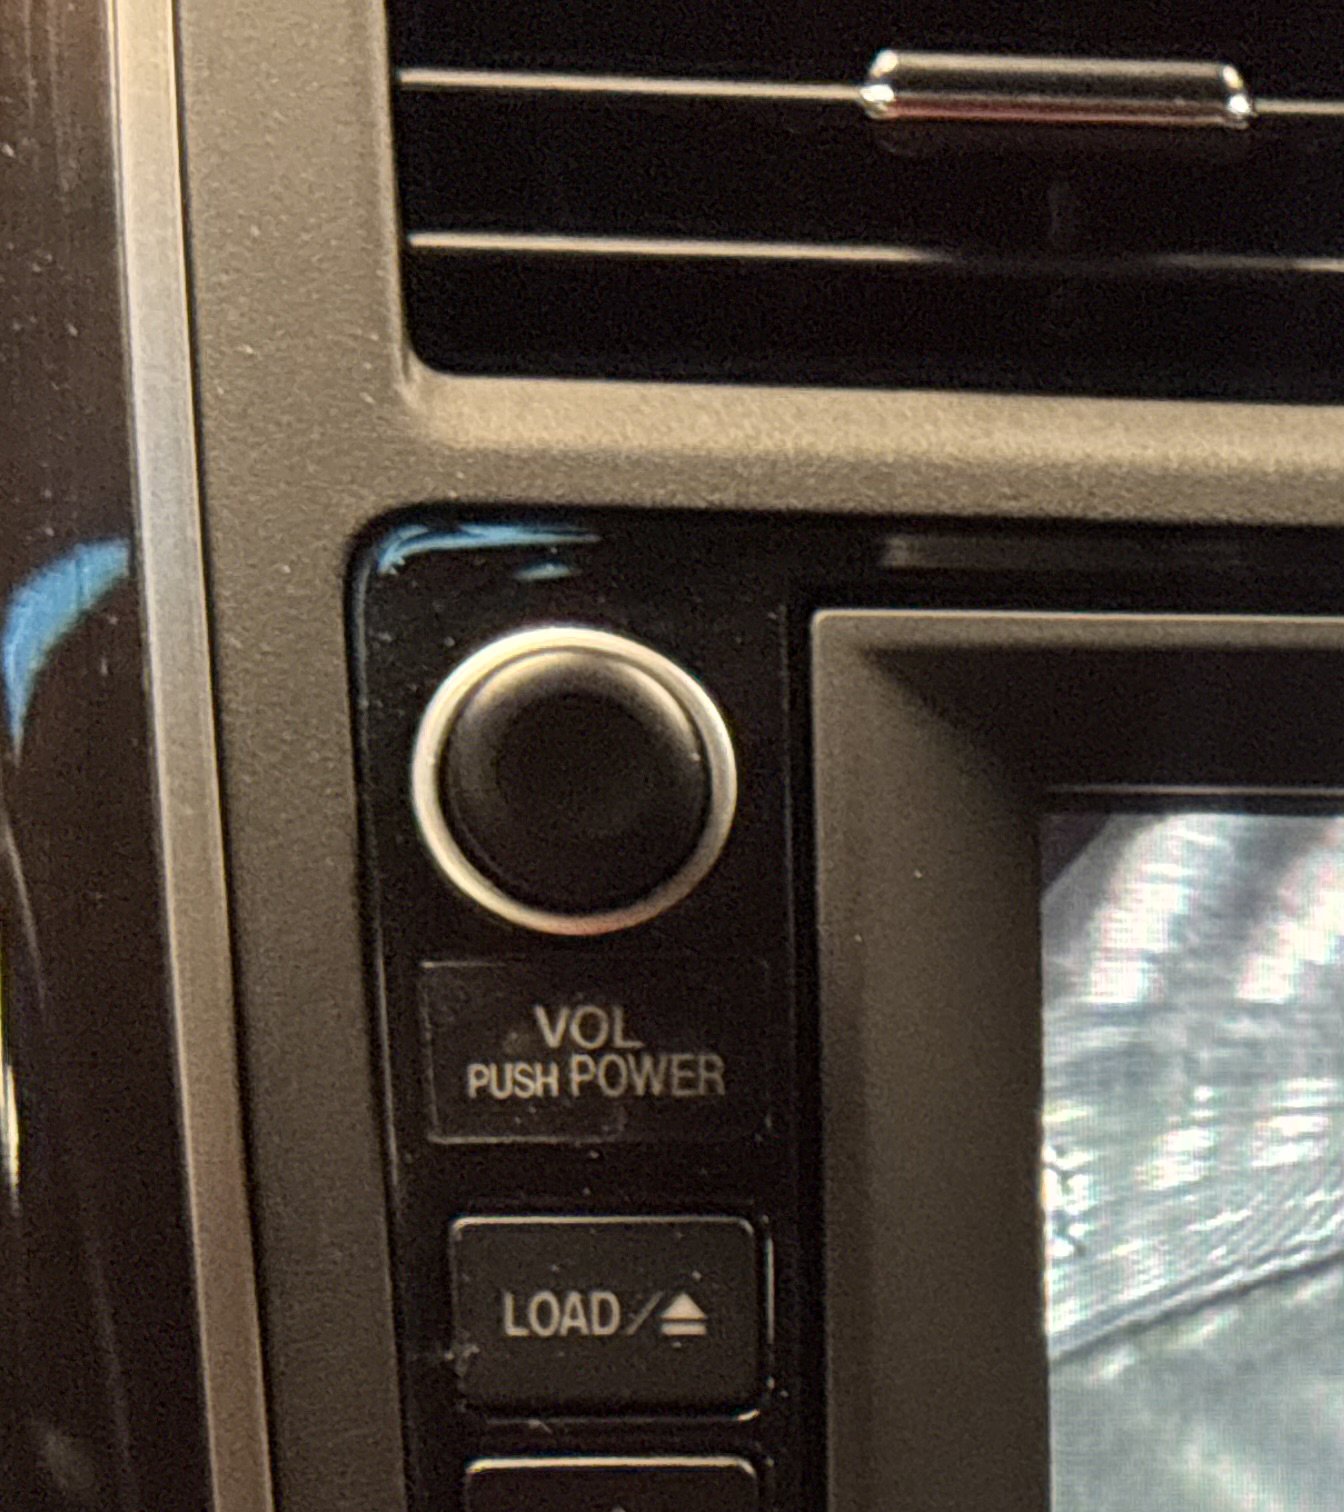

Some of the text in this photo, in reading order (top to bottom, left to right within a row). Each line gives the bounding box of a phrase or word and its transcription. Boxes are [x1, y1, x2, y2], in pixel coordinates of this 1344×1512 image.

[533, 1004, 645, 1050] VOL
[465, 1052, 727, 1099] PUSH POWER
